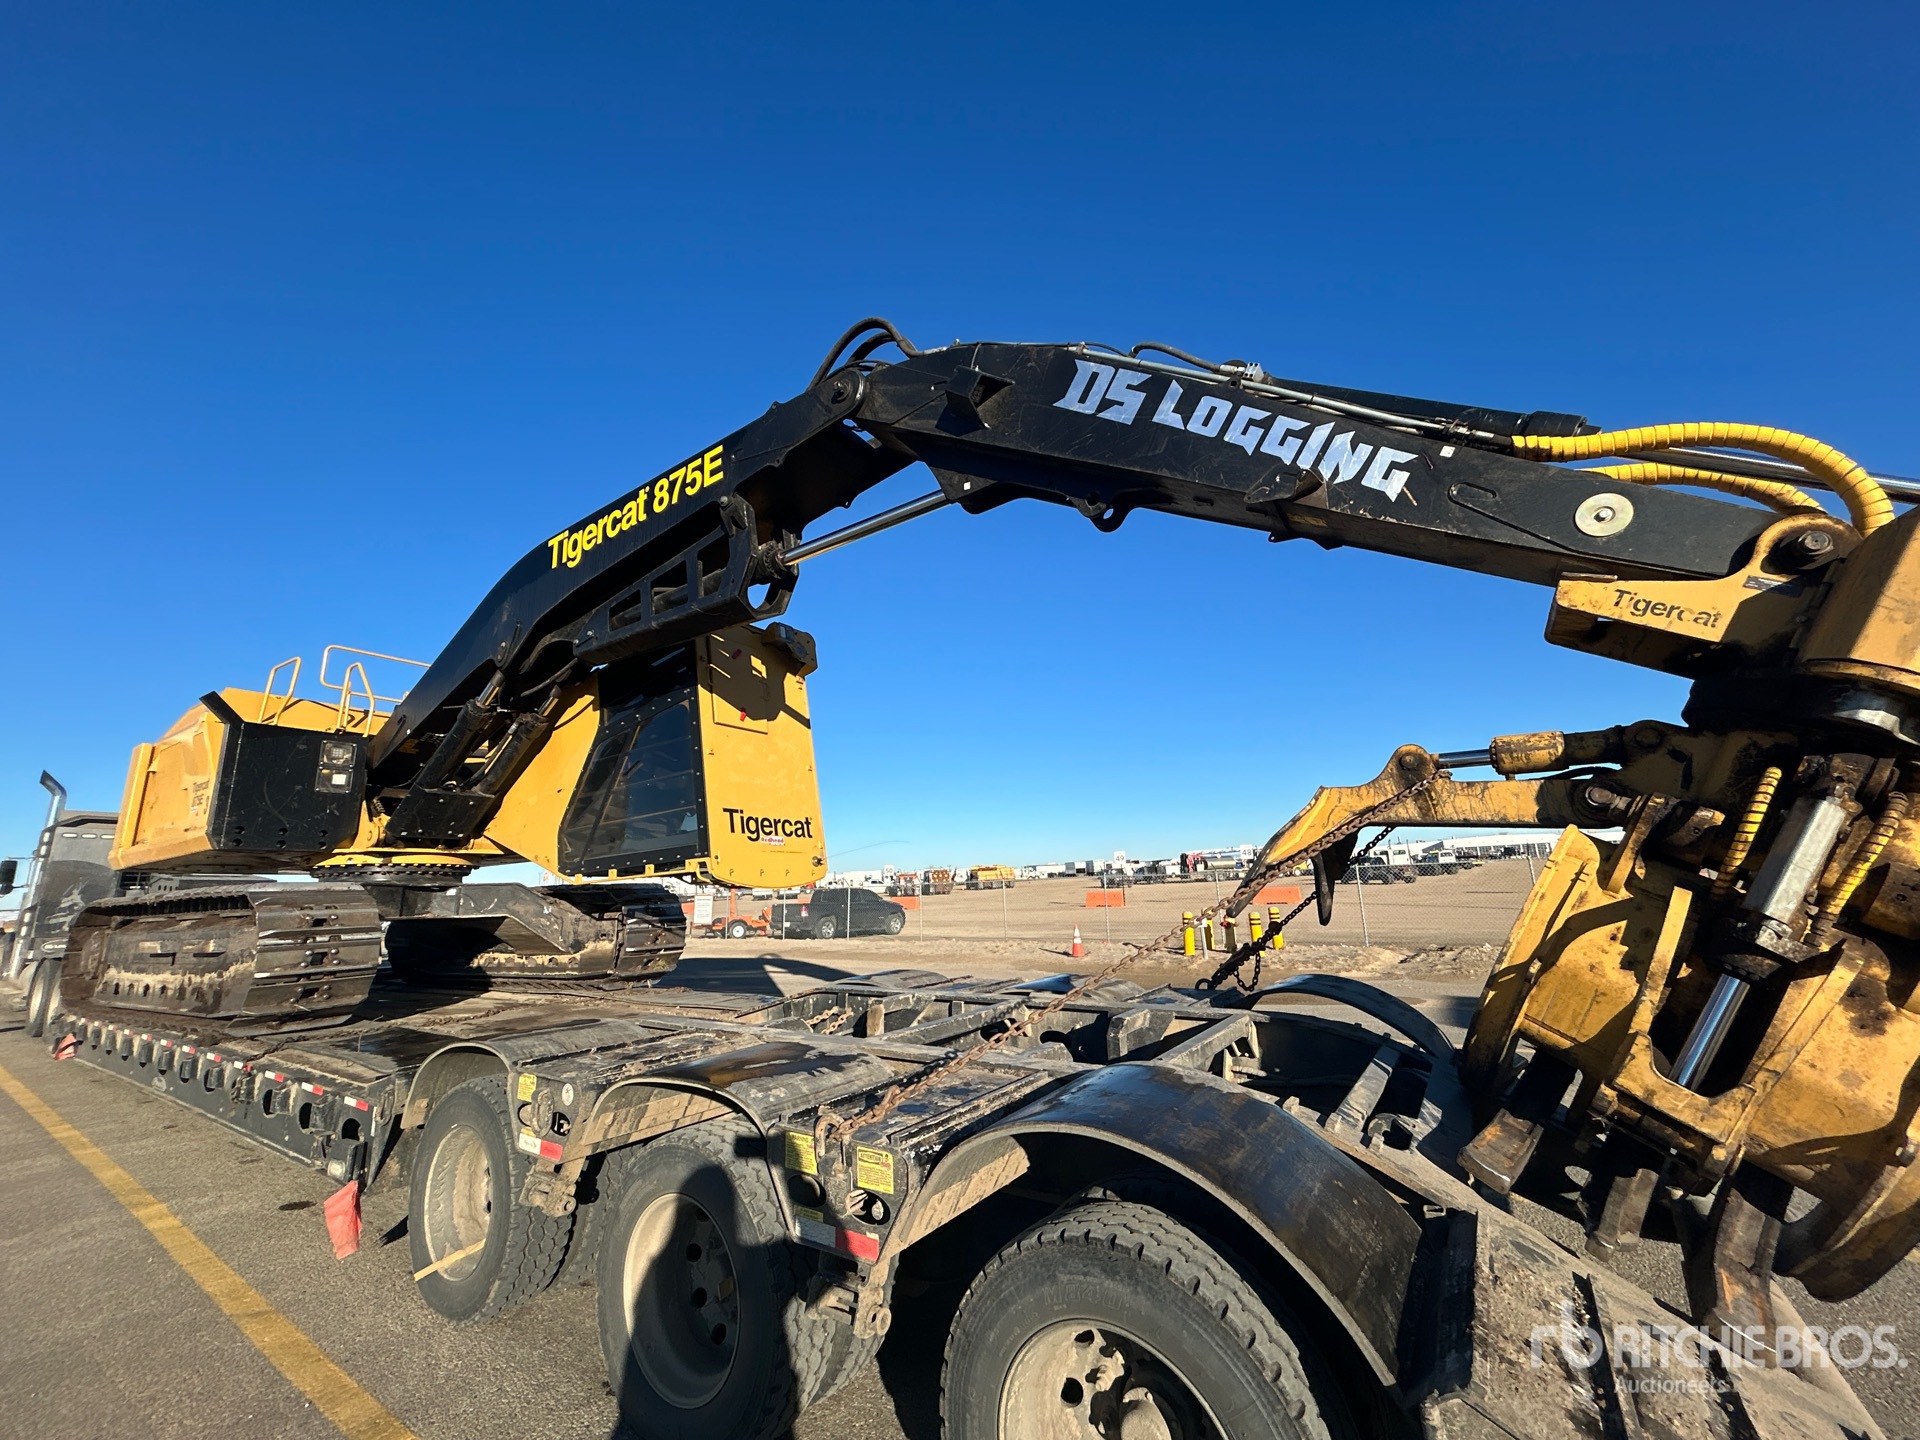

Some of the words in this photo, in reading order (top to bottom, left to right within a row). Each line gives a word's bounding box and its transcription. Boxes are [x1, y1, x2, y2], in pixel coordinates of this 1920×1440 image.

[1053, 358, 1152, 426] DS
[1152, 379, 1419, 503] LOGGING
[547, 487, 648, 570] Tigercat
[652, 444, 724, 514] 875E
[1613, 588, 1722, 629] Tigercat
[722, 807, 813, 842] Tigercat
